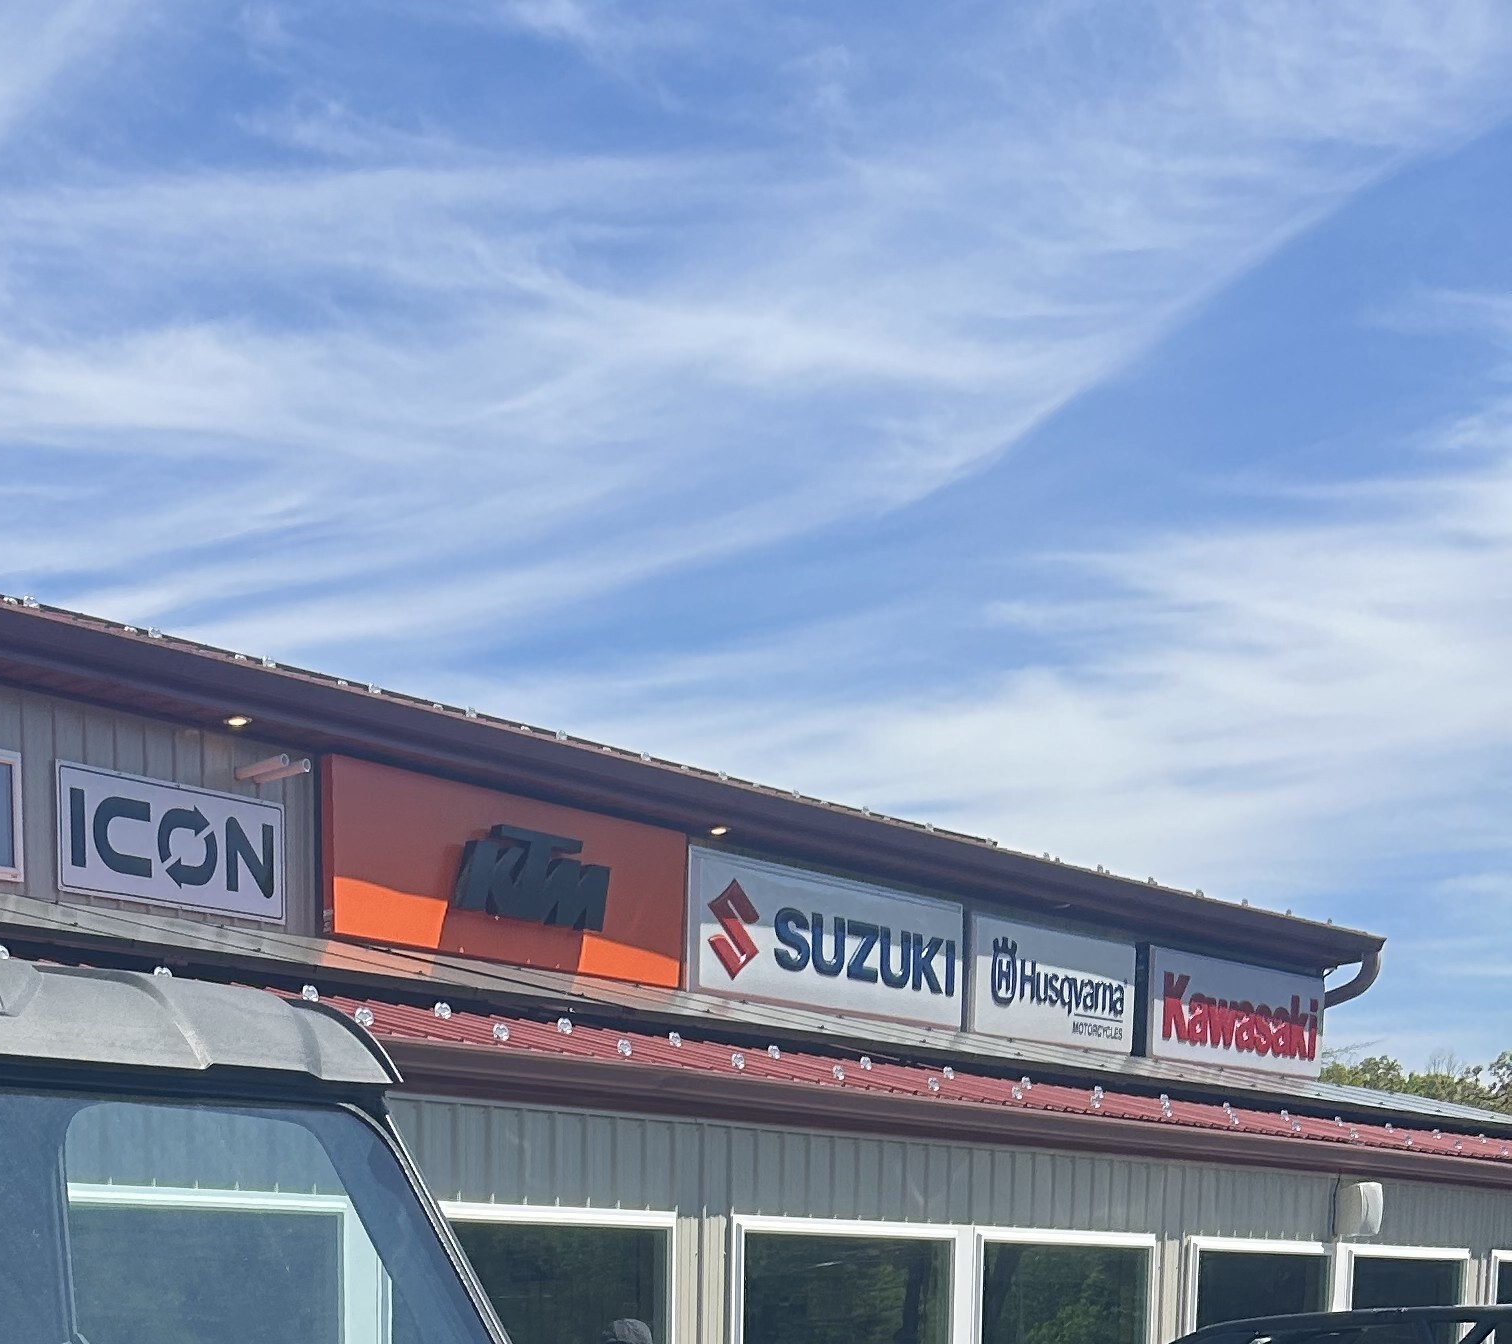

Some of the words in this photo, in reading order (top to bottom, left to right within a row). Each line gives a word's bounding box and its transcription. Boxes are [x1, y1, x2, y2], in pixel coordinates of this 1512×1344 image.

[69, 787, 275, 899] ICON
[454, 824, 611, 931] KTM
[773, 907, 955, 997] SUZUKI
[1019, 958, 1125, 1017] Husqvarna
[1072, 1021, 1123, 1041] MOTORCYCLES
[1161, 970, 1319, 1061] Kawasaki
